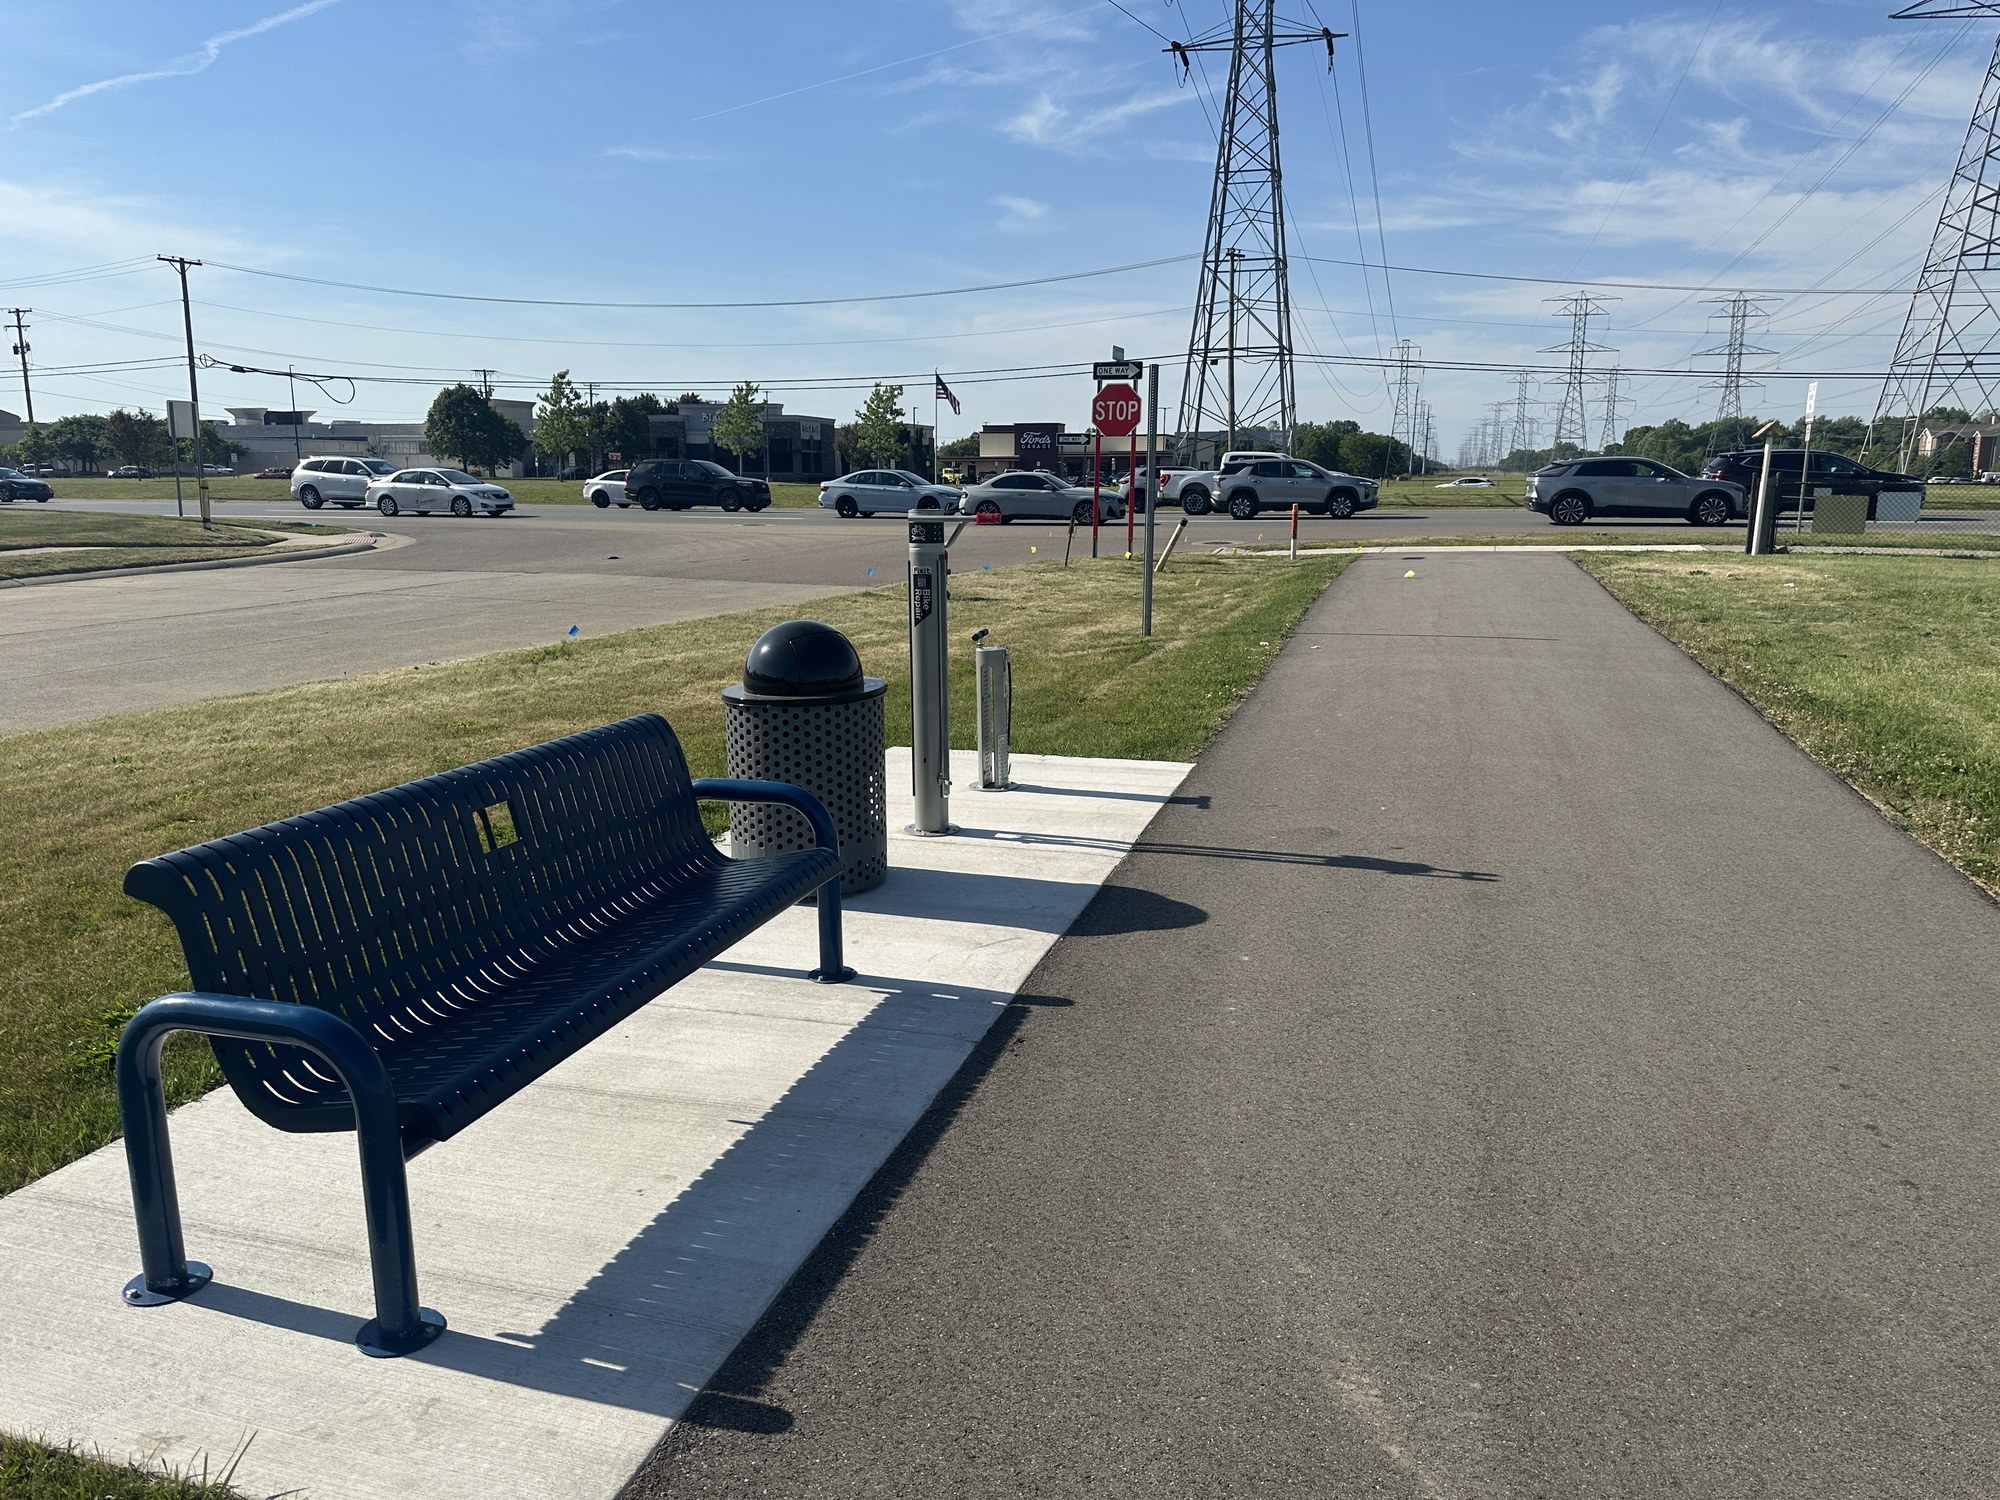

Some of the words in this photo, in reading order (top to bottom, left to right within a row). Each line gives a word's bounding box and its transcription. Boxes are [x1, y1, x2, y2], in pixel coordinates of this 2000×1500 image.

[1098, 367, 1113, 375] ONE
[1114, 367, 1129, 375] WAY
[1095, 400, 1138, 420] STOP
[1020, 431, 1051, 444] Ford's
[915, 588, 923, 620] Repair
[922, 589, 931, 610] Bike
